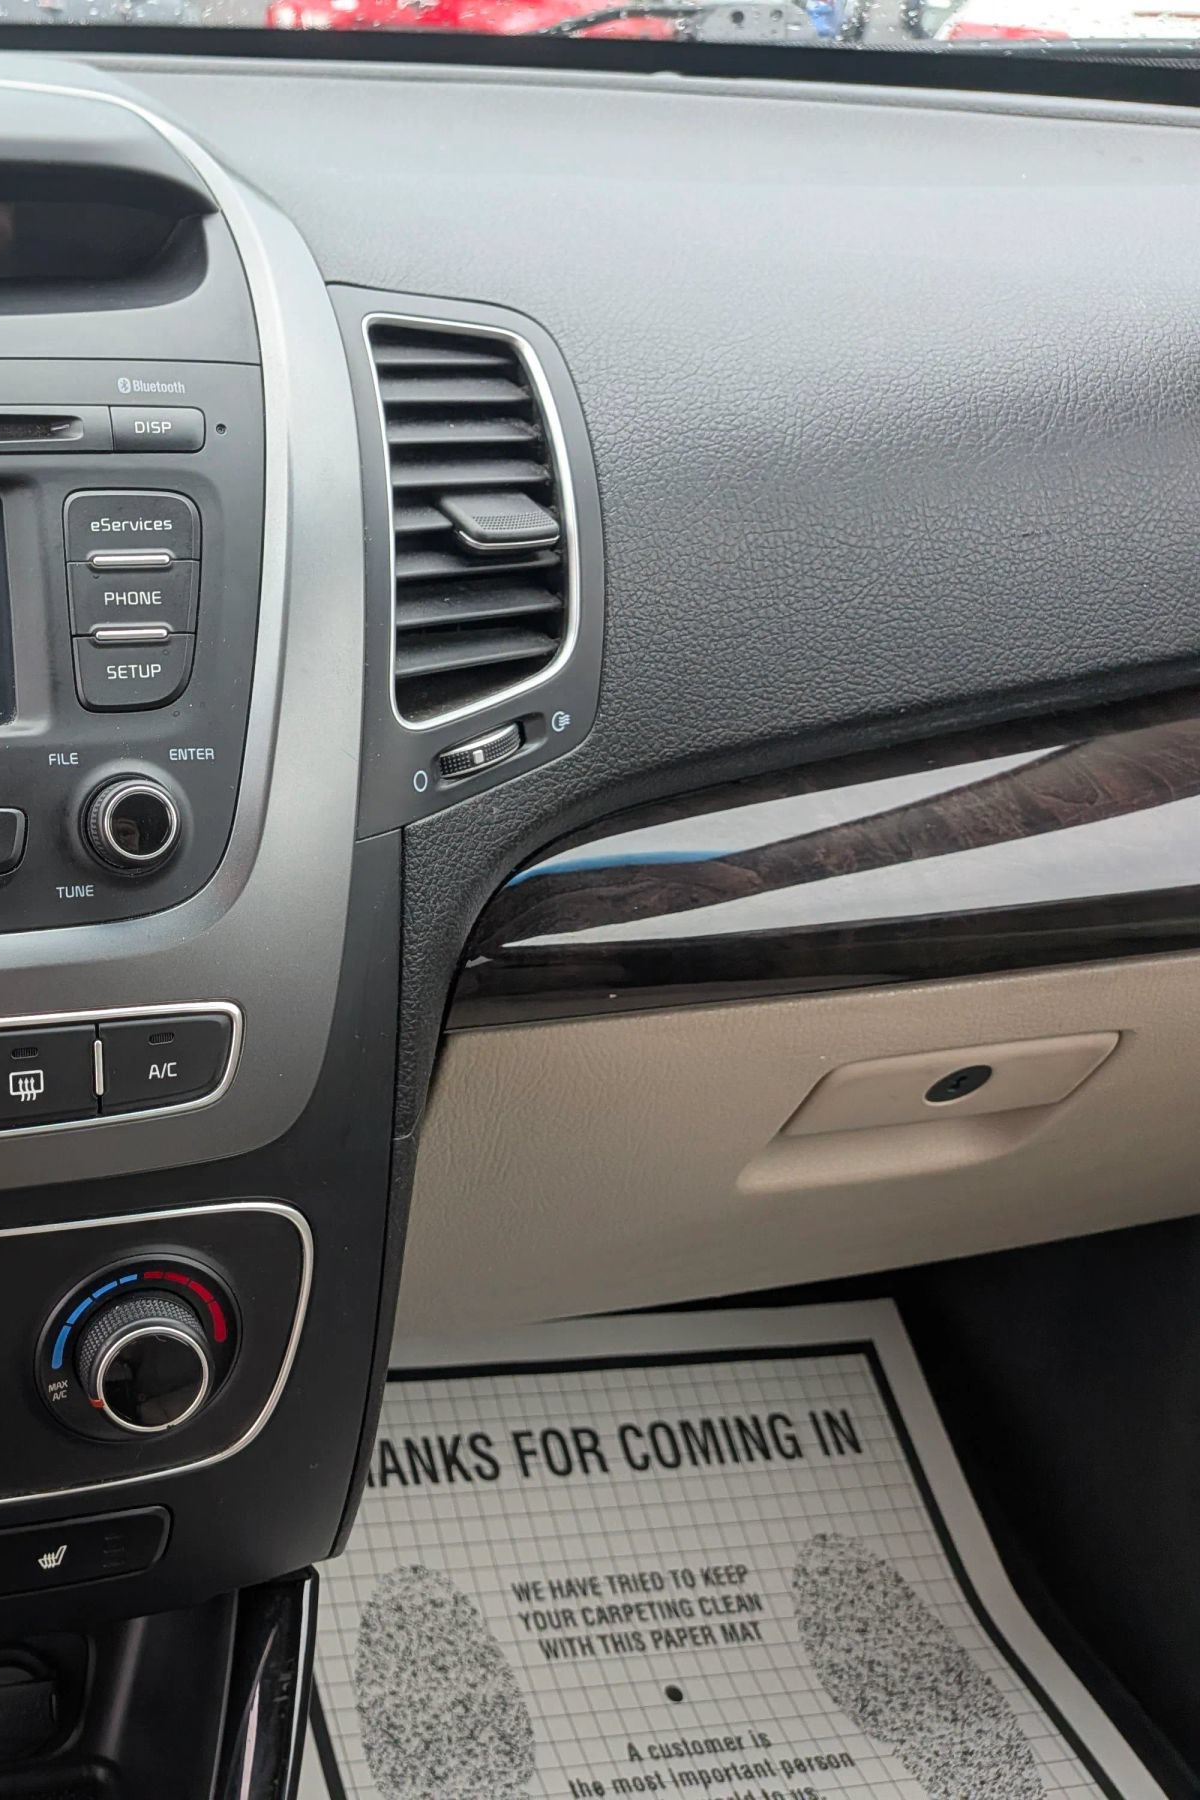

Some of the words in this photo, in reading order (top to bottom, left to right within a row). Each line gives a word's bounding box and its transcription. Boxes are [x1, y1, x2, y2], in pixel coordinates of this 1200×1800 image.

[132, 379, 186, 394] Bluetooth
[134, 421, 172, 434] DISP
[90, 517, 173, 533] eServices
[103, 590, 163, 606] PHONE
[106, 663, 162, 680] SETUP
[48, 751, 79, 766] FILE
[169, 747, 215, 762] ENTER
[55, 884, 95, 899] TUNE
[148, 1061, 178, 1080] A/C
[48, 1380, 68, 1393] MAX
[52, 1389, 67, 1401] A/C
[366, 1432, 501, 1488] ANKS
[512, 1427, 609, 1477] FOR
[618, 1411, 803, 1472] COMING
[808, 1408, 864, 1457] IN
[511, 1580, 547, 1601] WE
[548, 1575, 603, 1600] HAVE
[605, 1570, 666, 1595] TRIED
[668, 1567, 698, 1589] TO
[700, 1563, 750, 1587] KEEP
[518, 1607, 580, 1632] YOUR
[581, 1598, 694, 1627] CARPETING
[698, 1593, 765, 1617] CLEAN
[538, 1635, 595, 1661] WITH
[598, 1629, 648, 1655] THIS
[651, 1624, 718, 1650] PAPER
[719, 1620, 765, 1644] MAT
[626, 1742, 644, 1762] A
[649, 1734, 746, 1761] customer
[748, 1729, 773, 1749] is
[568, 1778, 607, 1800] the
[611, 1769, 667, 1795] most
[779, 1749, 856, 1779] person
